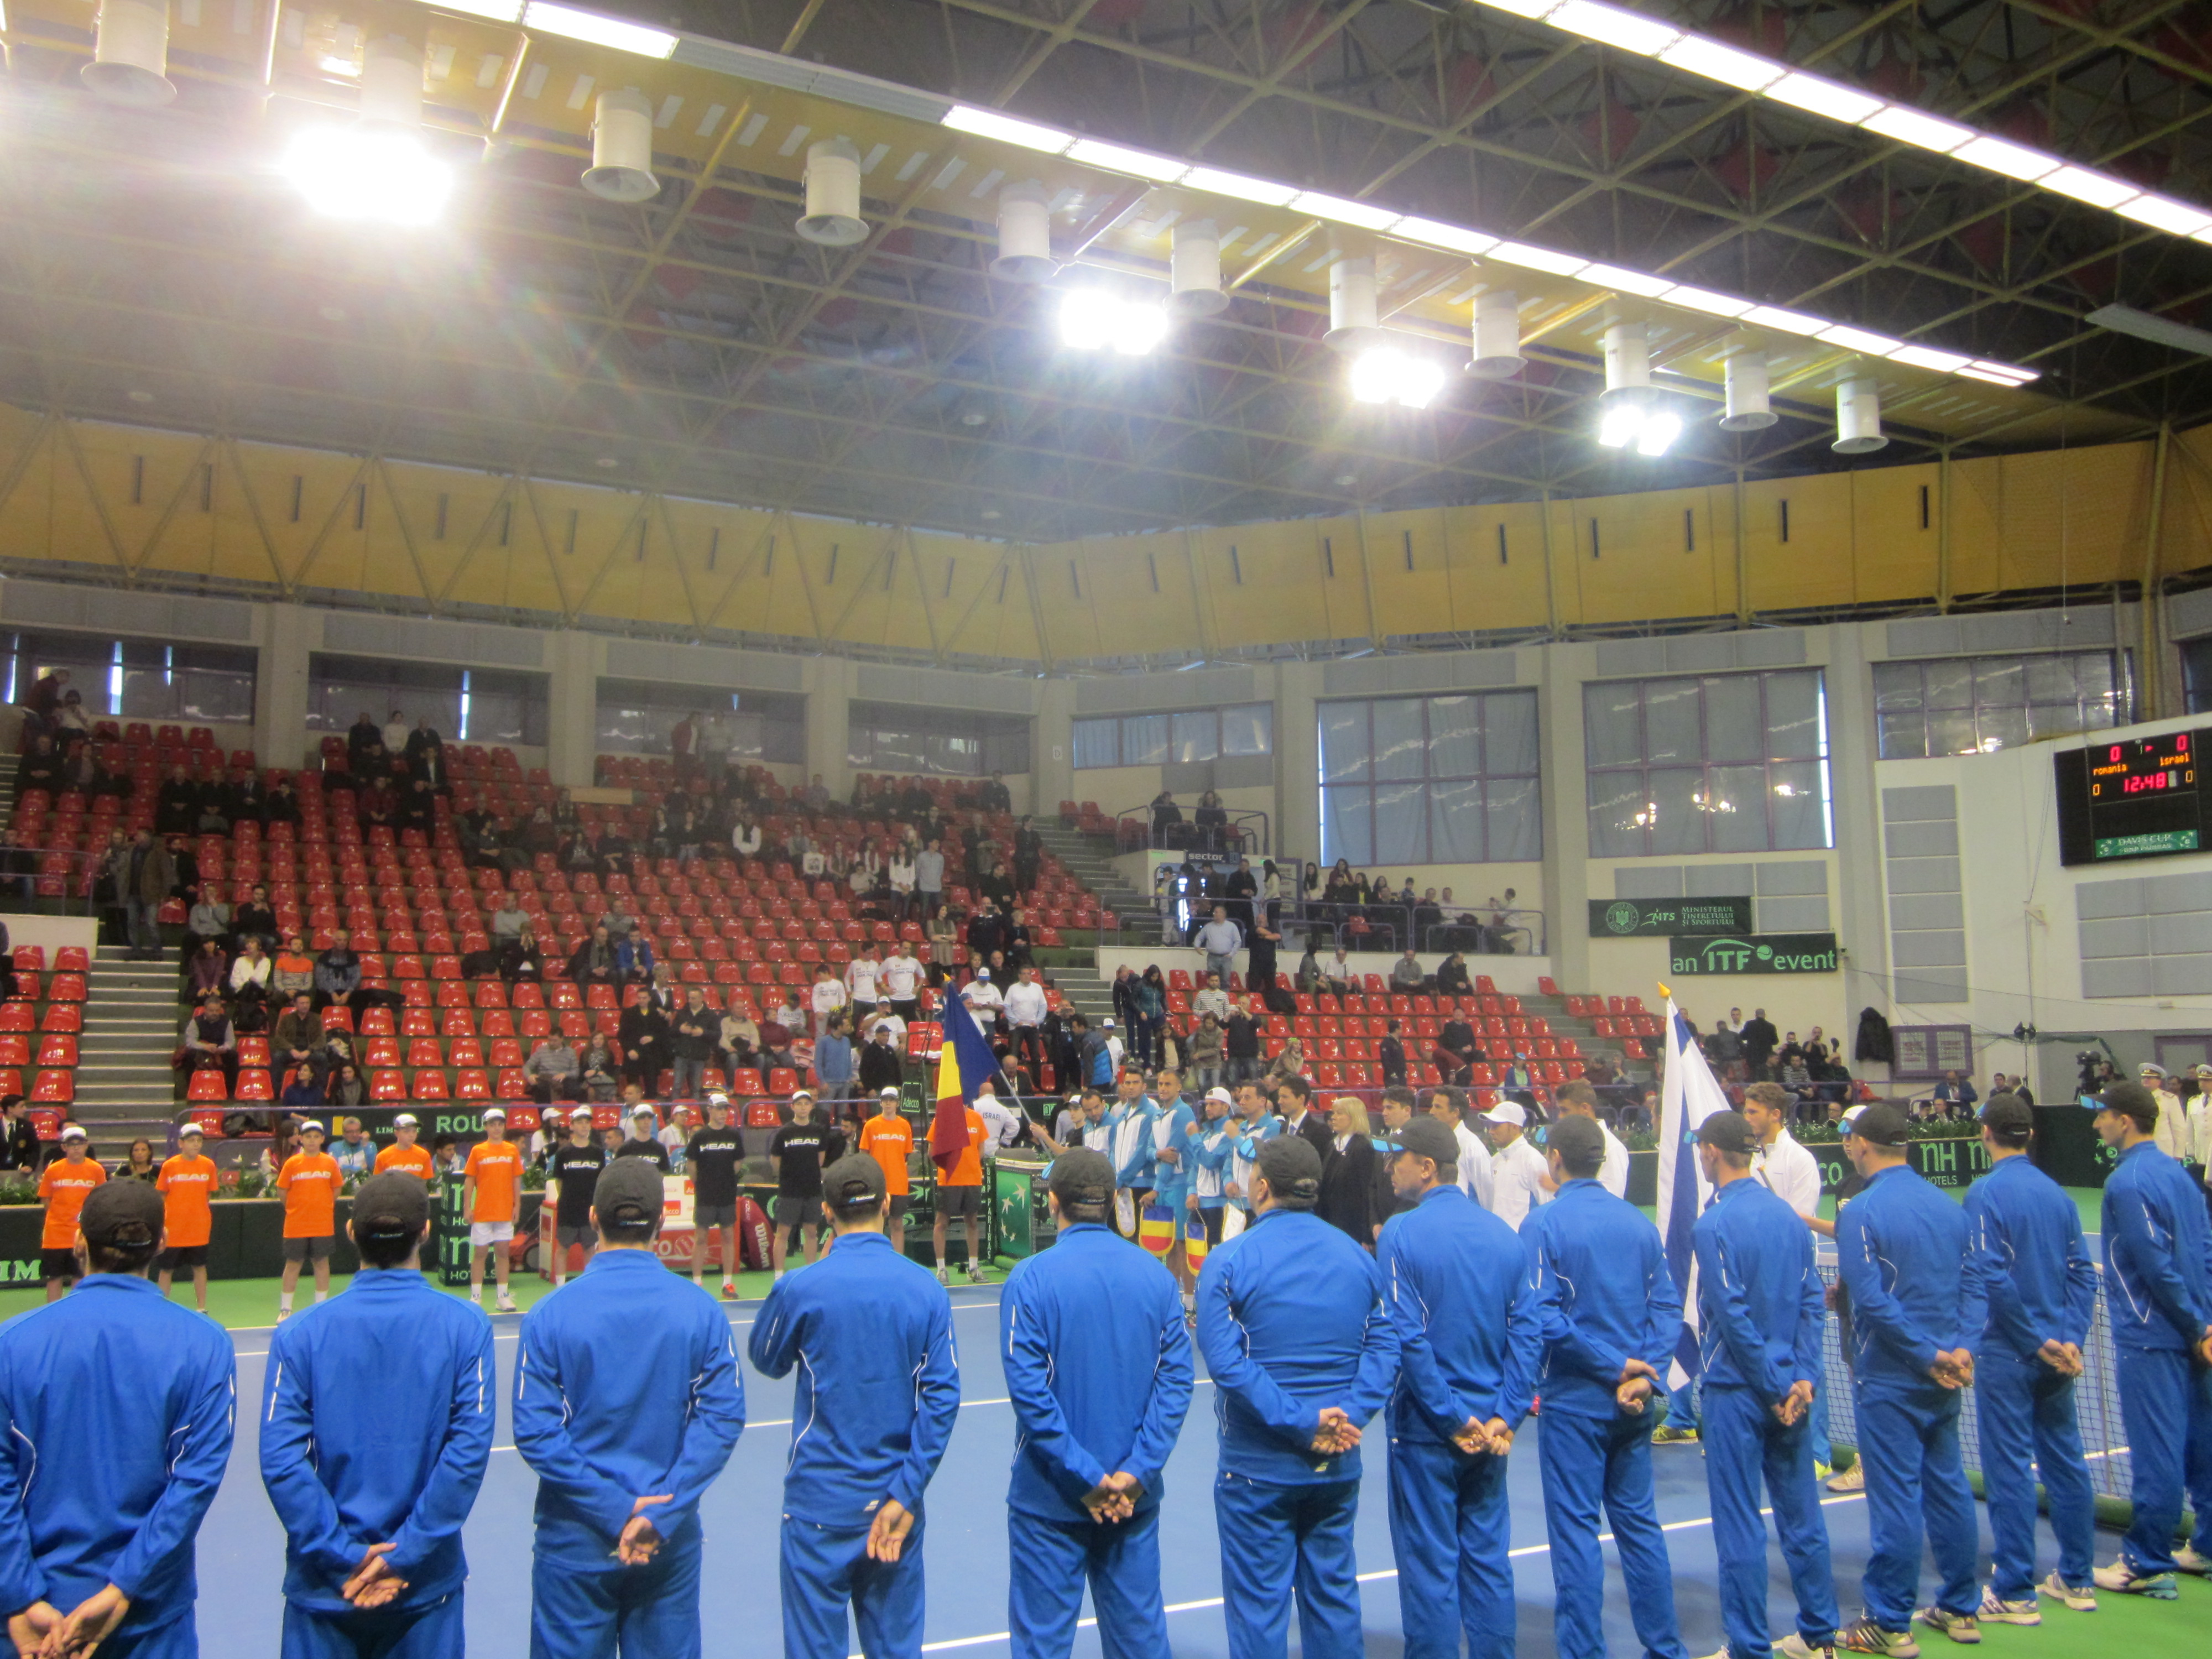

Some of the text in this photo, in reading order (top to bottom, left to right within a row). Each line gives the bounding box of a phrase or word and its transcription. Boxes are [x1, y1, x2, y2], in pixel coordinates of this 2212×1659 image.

[2110, 746, 2122, 762] 0
[1672, 950, 1835, 972] an ITF event
[983, 1112, 1000, 1121] ISRAEL
[700, 1142, 736, 1152] HEAD
[784, 1138, 820, 1147] HEAD
[563, 1161, 599, 1170] HEAD
[167, 1173, 210, 1182] HEAD
[291, 1171, 331, 1181] HEAD
[1924, 1174, 1958, 1185] HOTELS
[52, 1178, 96, 1187] HEAD
[754, 1222, 770, 1269] Wilson
